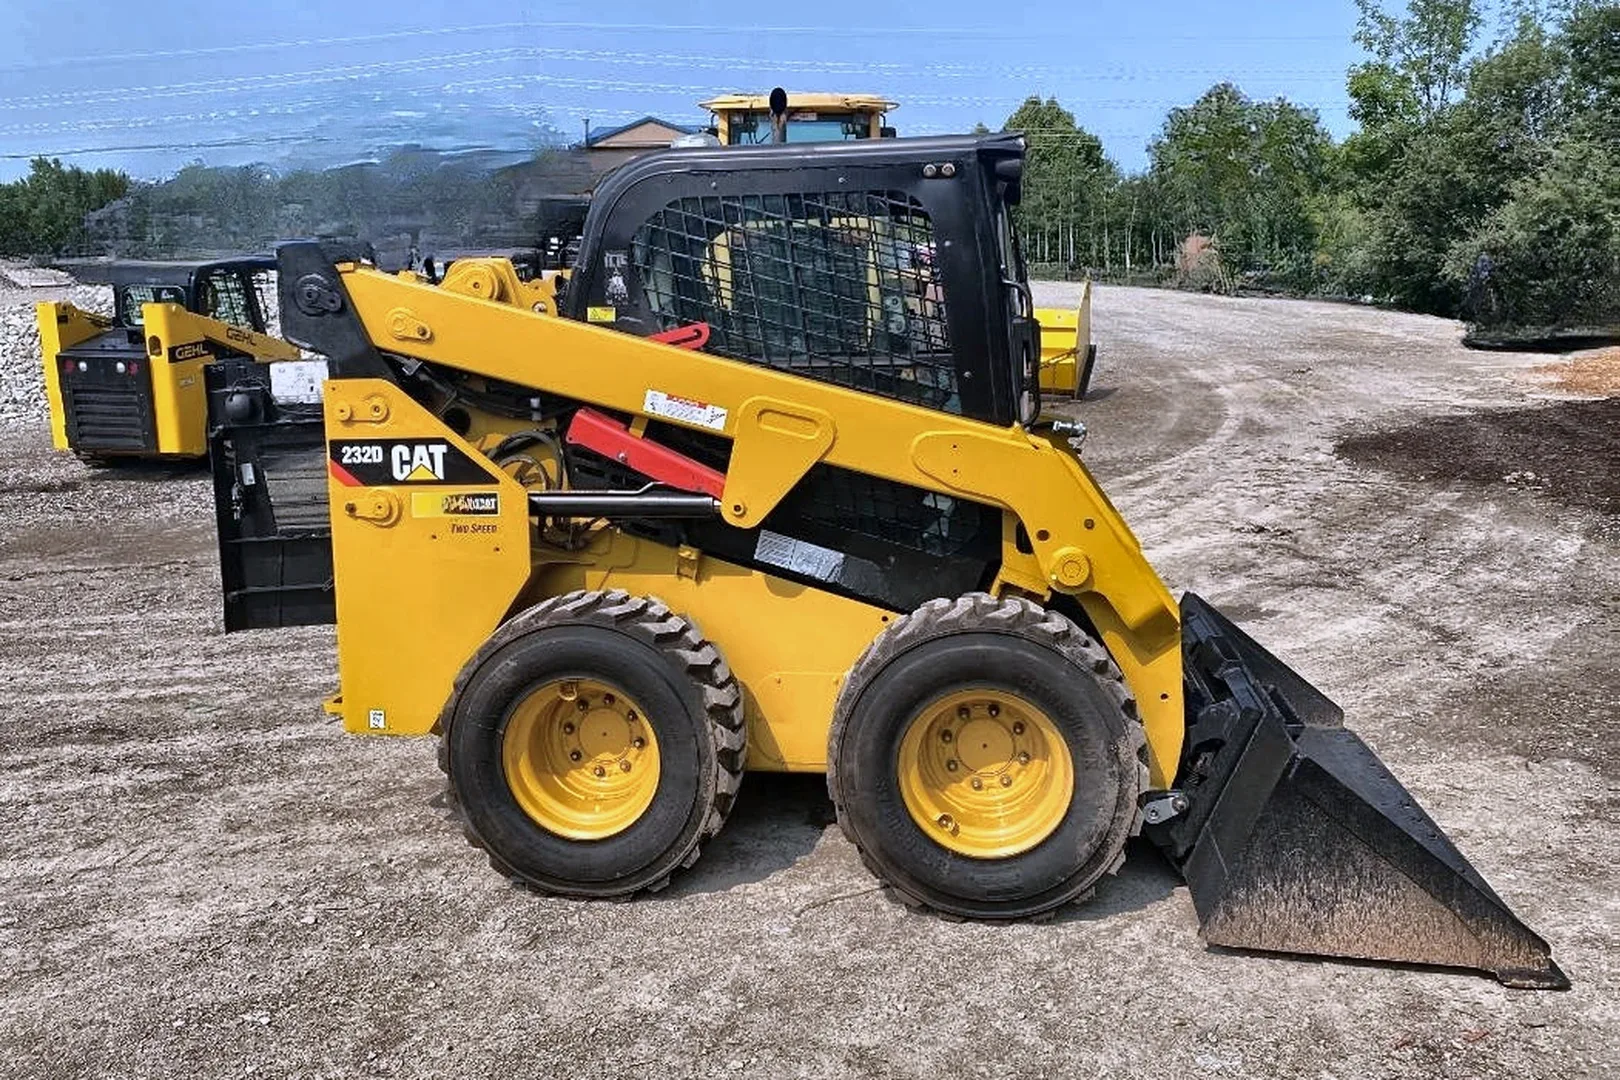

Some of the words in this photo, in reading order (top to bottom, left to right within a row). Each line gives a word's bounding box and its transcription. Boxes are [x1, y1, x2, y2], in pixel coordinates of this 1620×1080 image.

[226, 327, 257, 346] GEHL
[175, 343, 208, 359] GEHL
[341, 445, 383, 464] 232D
[391, 444, 447, 481] CAT
